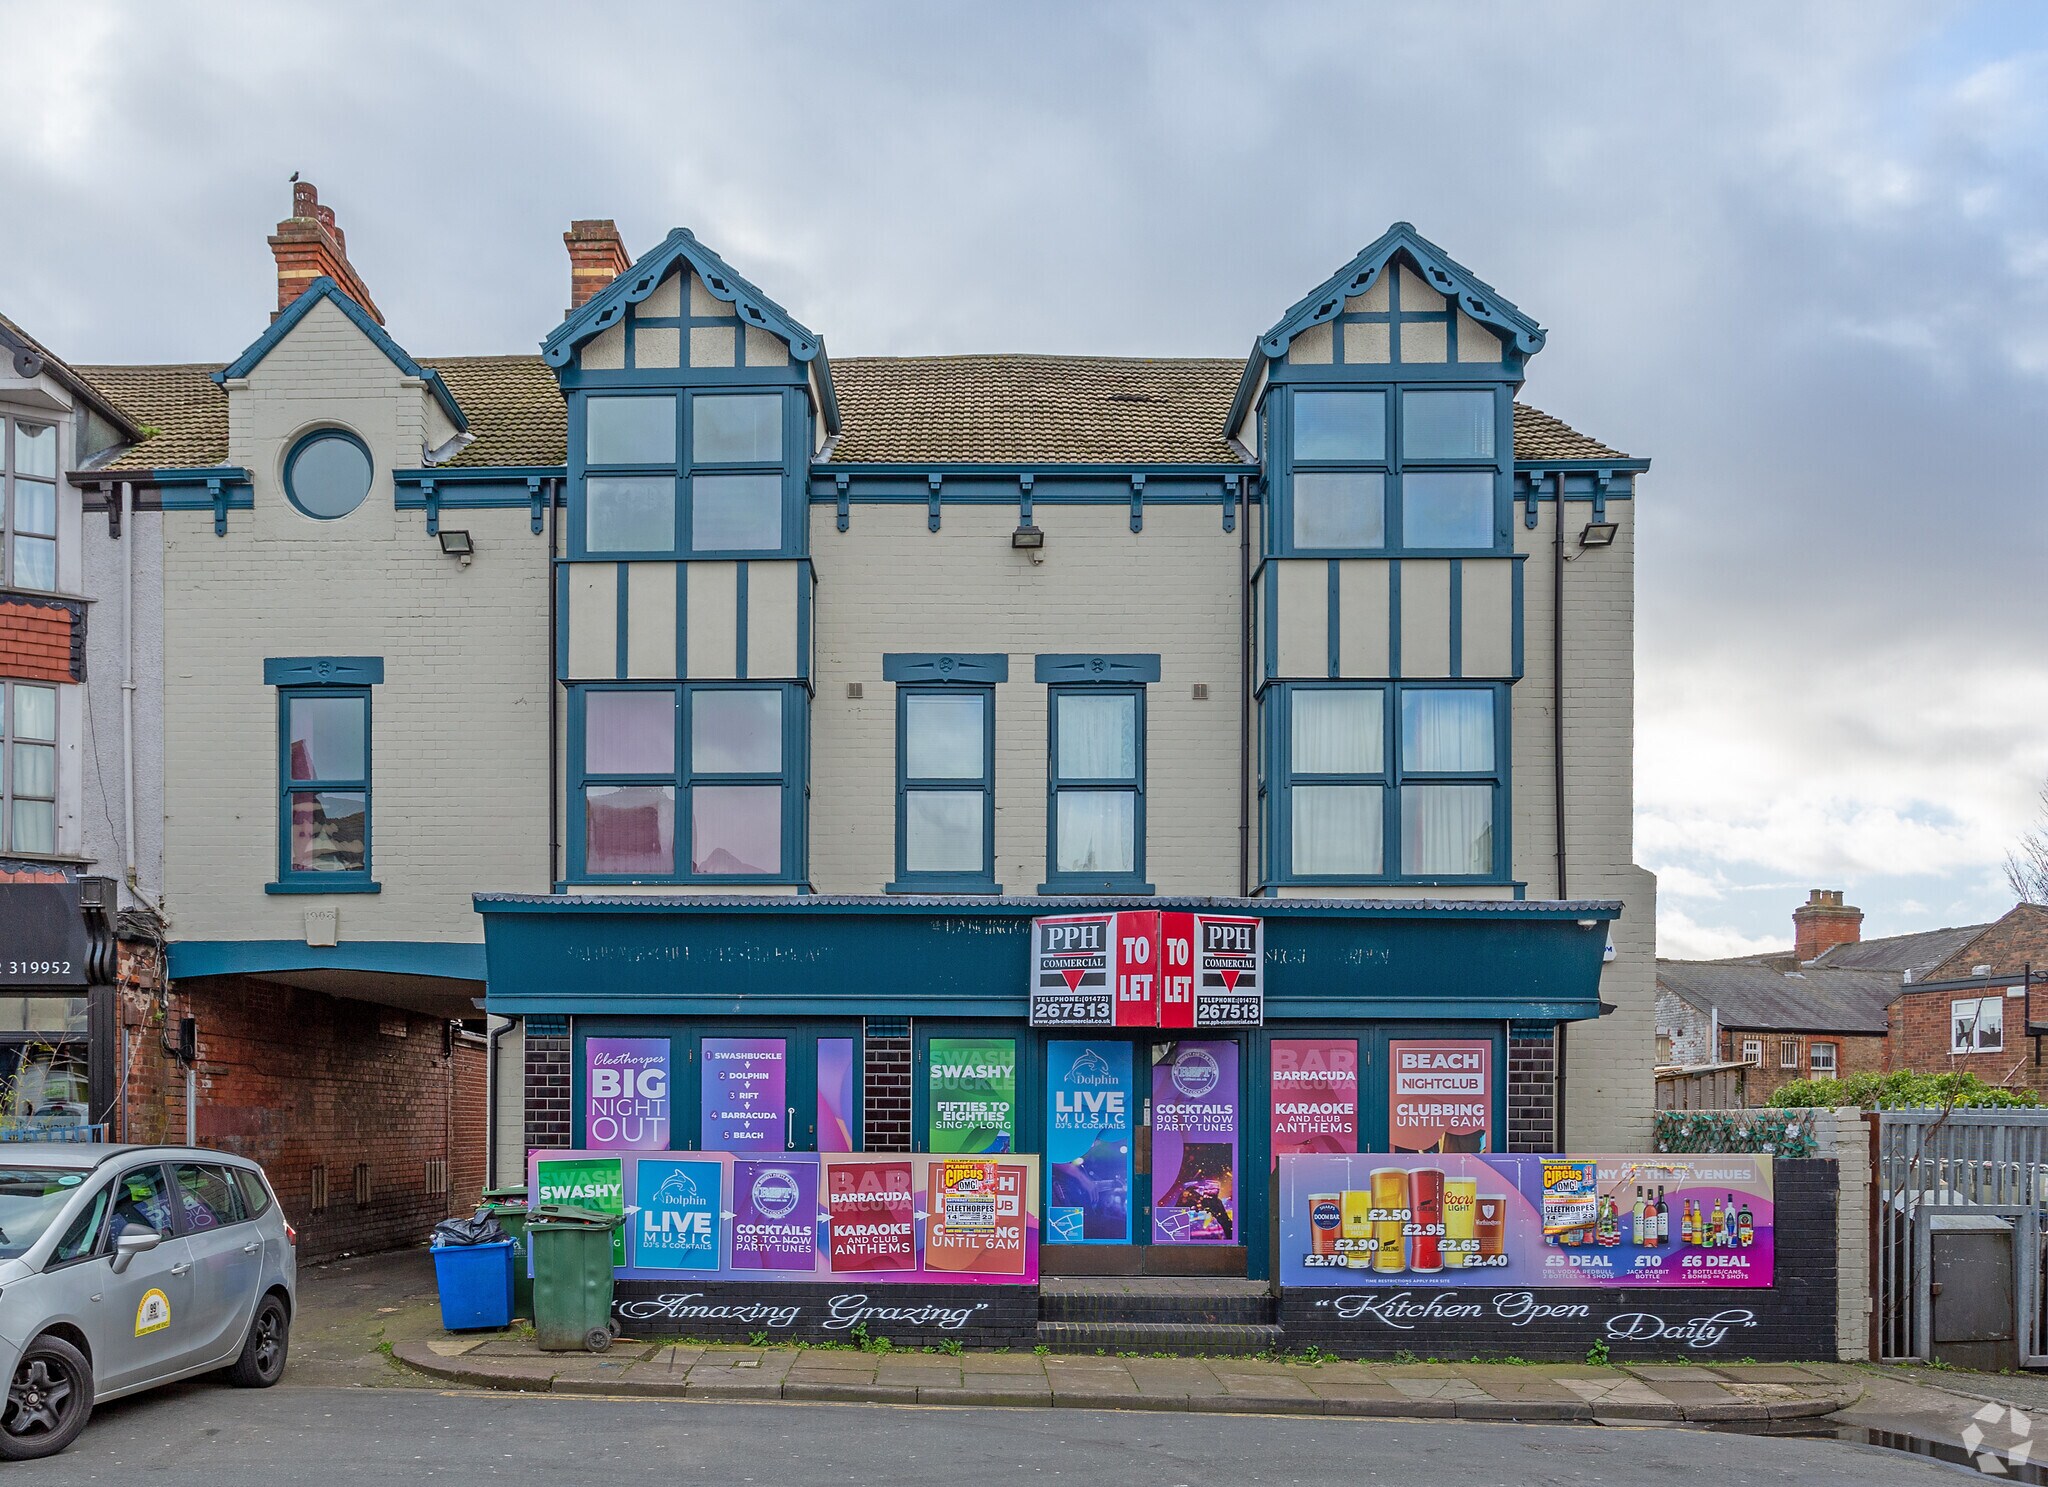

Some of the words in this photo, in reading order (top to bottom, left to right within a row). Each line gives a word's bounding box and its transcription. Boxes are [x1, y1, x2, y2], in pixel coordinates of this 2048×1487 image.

[1047, 925, 1100, 950] PPH
[1208, 925, 1252, 950] PPH
[1122, 936, 1150, 965] TO
[1166, 937, 1189, 966] TO
[9, 961, 70, 974] 319952
[1043, 958, 1104, 969] COMMERCIAL
[1204, 958, 1254, 969] COMMERCIAL
[1119, 974, 1153, 1002] LET
[1164, 975, 1192, 1003] LET
[1035, 1003, 1110, 1018] 267513
[1199, 1004, 1259, 1019] 267513
[594, 1052, 666, 1069] Cleethorpes
[714, 1052, 783, 1060] SWASHBUCKLE
[1402, 1053, 1479, 1069] BEACH
[931, 1065, 1014, 1078] SWASHY
[1273, 1071, 1356, 1081] BARRACUDA
[592, 1068, 667, 1099] BIG
[1077, 1074, 1119, 1087] Dolphin
[1402, 1078, 1479, 1089] NIGHTCLUB
[592, 1099, 666, 1116] NIGHT
[937, 1101, 987, 1112] FIFTIES
[990, 1101, 1010, 1112] TO
[1056, 1091, 1125, 1113] LIVE
[1156, 1104, 1233, 1115] COCKTAILS
[1275, 1103, 1354, 1115] KARAOKE
[1396, 1103, 1485, 1116] CLUBBING
[943, 1111, 1005, 1121] EIGHTIES
[1056, 1112, 1125, 1124] MUSIC
[1156, 1115, 1179, 1123] 90S
[1184, 1115, 1199, 1123] TO
[1203, 1115, 1233, 1123] NOW
[1288, 1115, 1311, 1123] AND
[1313, 1115, 1341, 1123] CLUB
[1396, 1116, 1445, 1127] UNTIL
[1450, 1116, 1485, 1127] 6AM
[592, 1116, 666, 1142] OUT
[935, 1121, 1011, 1130] SING-A-LONG
[1156, 1123, 1191, 1132] PARTY
[1196, 1123, 1233, 1132] TUNES
[1275, 1122, 1353, 1133] ANTHEMS
[945, 1169, 984, 1188] CIRCUS
[1543, 1170, 1582, 1188] CIRCUS
[1645, 1169, 1690, 1180] THESE
[1694, 1169, 1751, 1180] VENUES
[540, 1183, 621, 1200] SWASHY
[959, 1180, 979, 1190] OMG!
[1557, 1180, 1578, 1191] OMG!
[665, 1194, 706, 1207] Dolphin
[830, 1191, 912, 1203] BARRACUDA
[1443, 1191, 1474, 1205] Coors
[946, 1204, 994, 1212] CLEETHORPES
[1368, 1208, 1412, 1221] £2.50
[1447, 1204, 1470, 1212] LIGHT
[1545, 1203, 1595, 1213] CLEETHORPES
[644, 1210, 712, 1234] LIVE
[736, 1223, 812, 1236] COCKTAILS
[833, 1223, 911, 1237] KARAOKE
[1402, 1223, 1446, 1236] £2.95
[644, 1231, 711, 1245] MUSIC
[736, 1234, 758, 1243] 90S
[762, 1235, 778, 1244] TO
[782, 1236, 812, 1245] NOW
[847, 1236, 869, 1244] AND
[872, 1235, 899, 1243] CLUB
[931, 1236, 980, 1249] UNTIL
[985, 1238, 1020, 1250] 6AM
[1334, 1238, 1379, 1251] £2.90
[669, 1242, 712, 1250] COCKTAILS
[736, 1243, 772, 1252] PARTY
[775, 1244, 812, 1253] TUNES
[834, 1242, 911, 1255] ANTHEMS
[1437, 1239, 1481, 1252] £2.65
[1304, 1254, 1348, 1267] £2.70
[1462, 1254, 1508, 1267] £2.40
[1545, 1254, 1565, 1267] £5
[1569, 1255, 1613, 1267] DEAL
[1634, 1254, 1662, 1267] £10
[1681, 1255, 1702, 1267] £6
[1706, 1255, 1750, 1267] DEAL
[1492, 1291, 1590, 1327] Open
